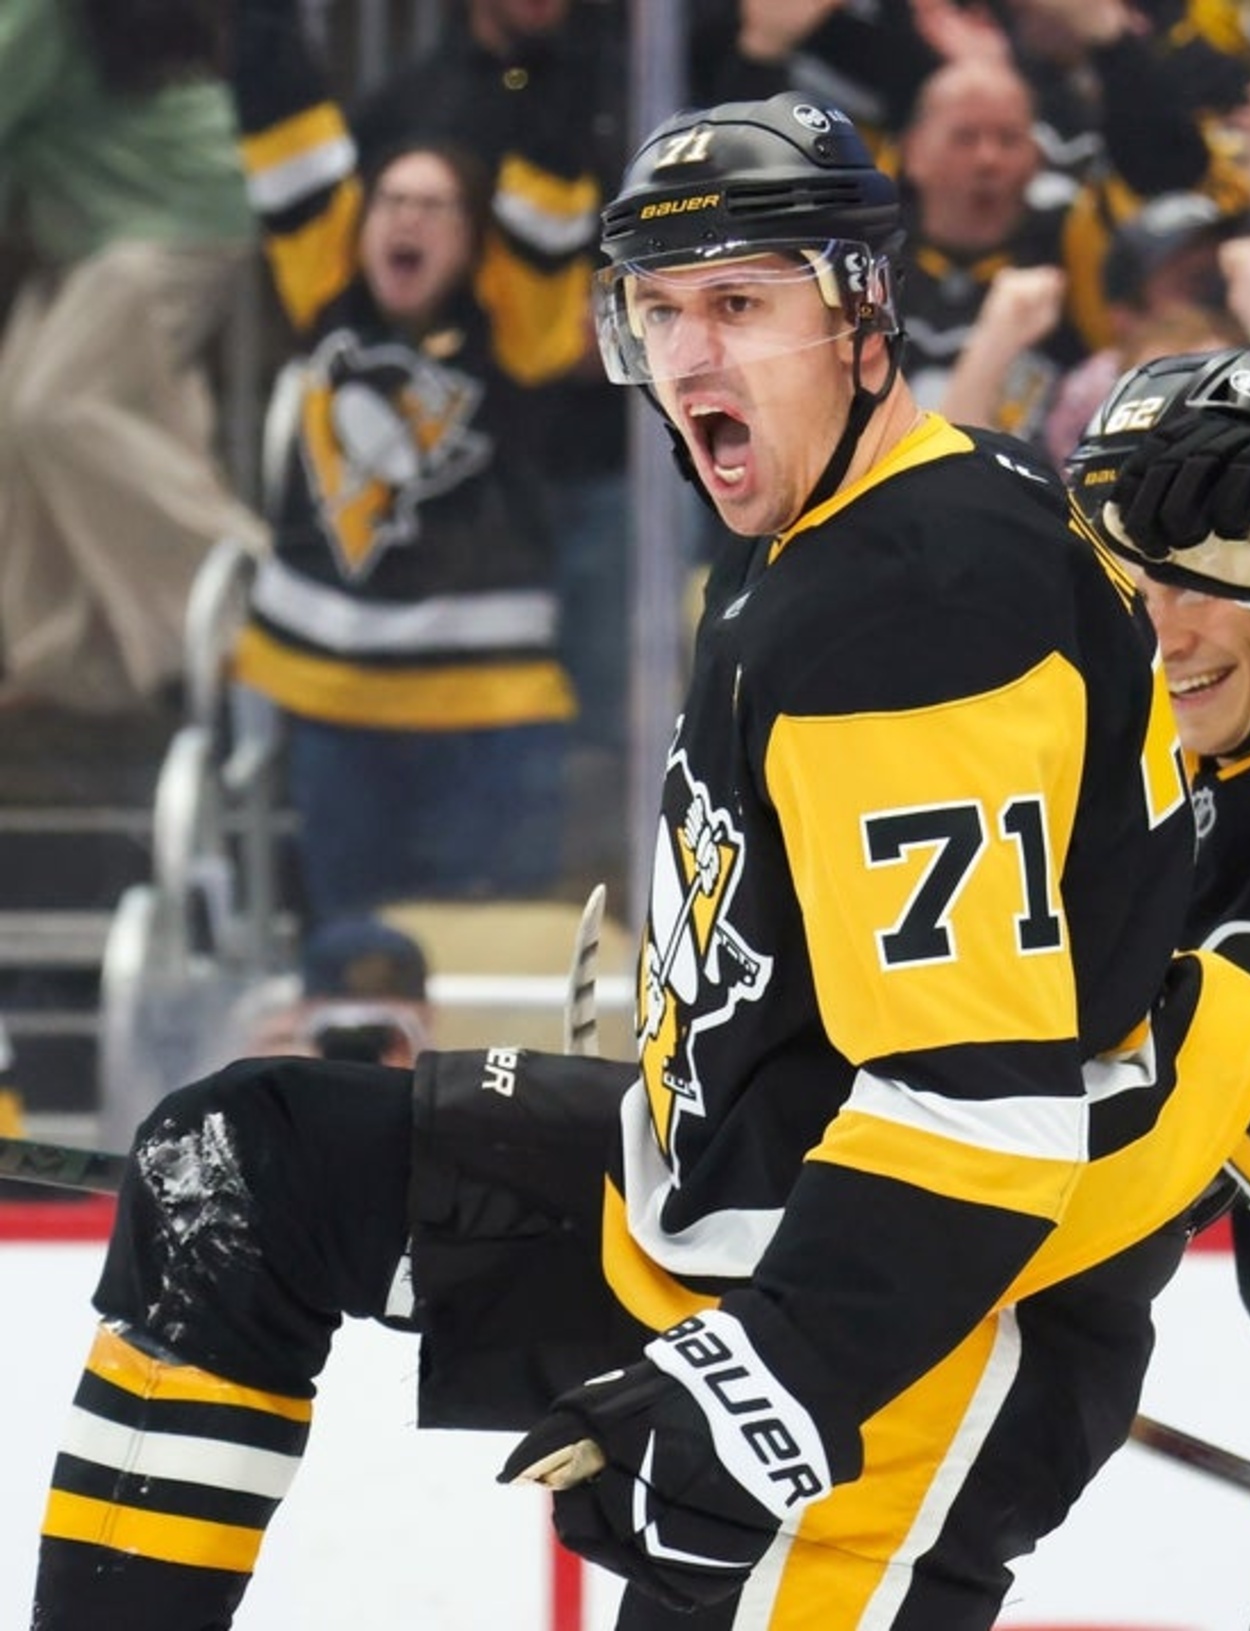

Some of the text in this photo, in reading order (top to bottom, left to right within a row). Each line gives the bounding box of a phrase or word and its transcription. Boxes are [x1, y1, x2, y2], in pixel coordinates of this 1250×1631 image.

[654, 126, 715, 169] 71
[1104, 396, 1165, 435] 62
[859, 792, 1066, 972] 71
